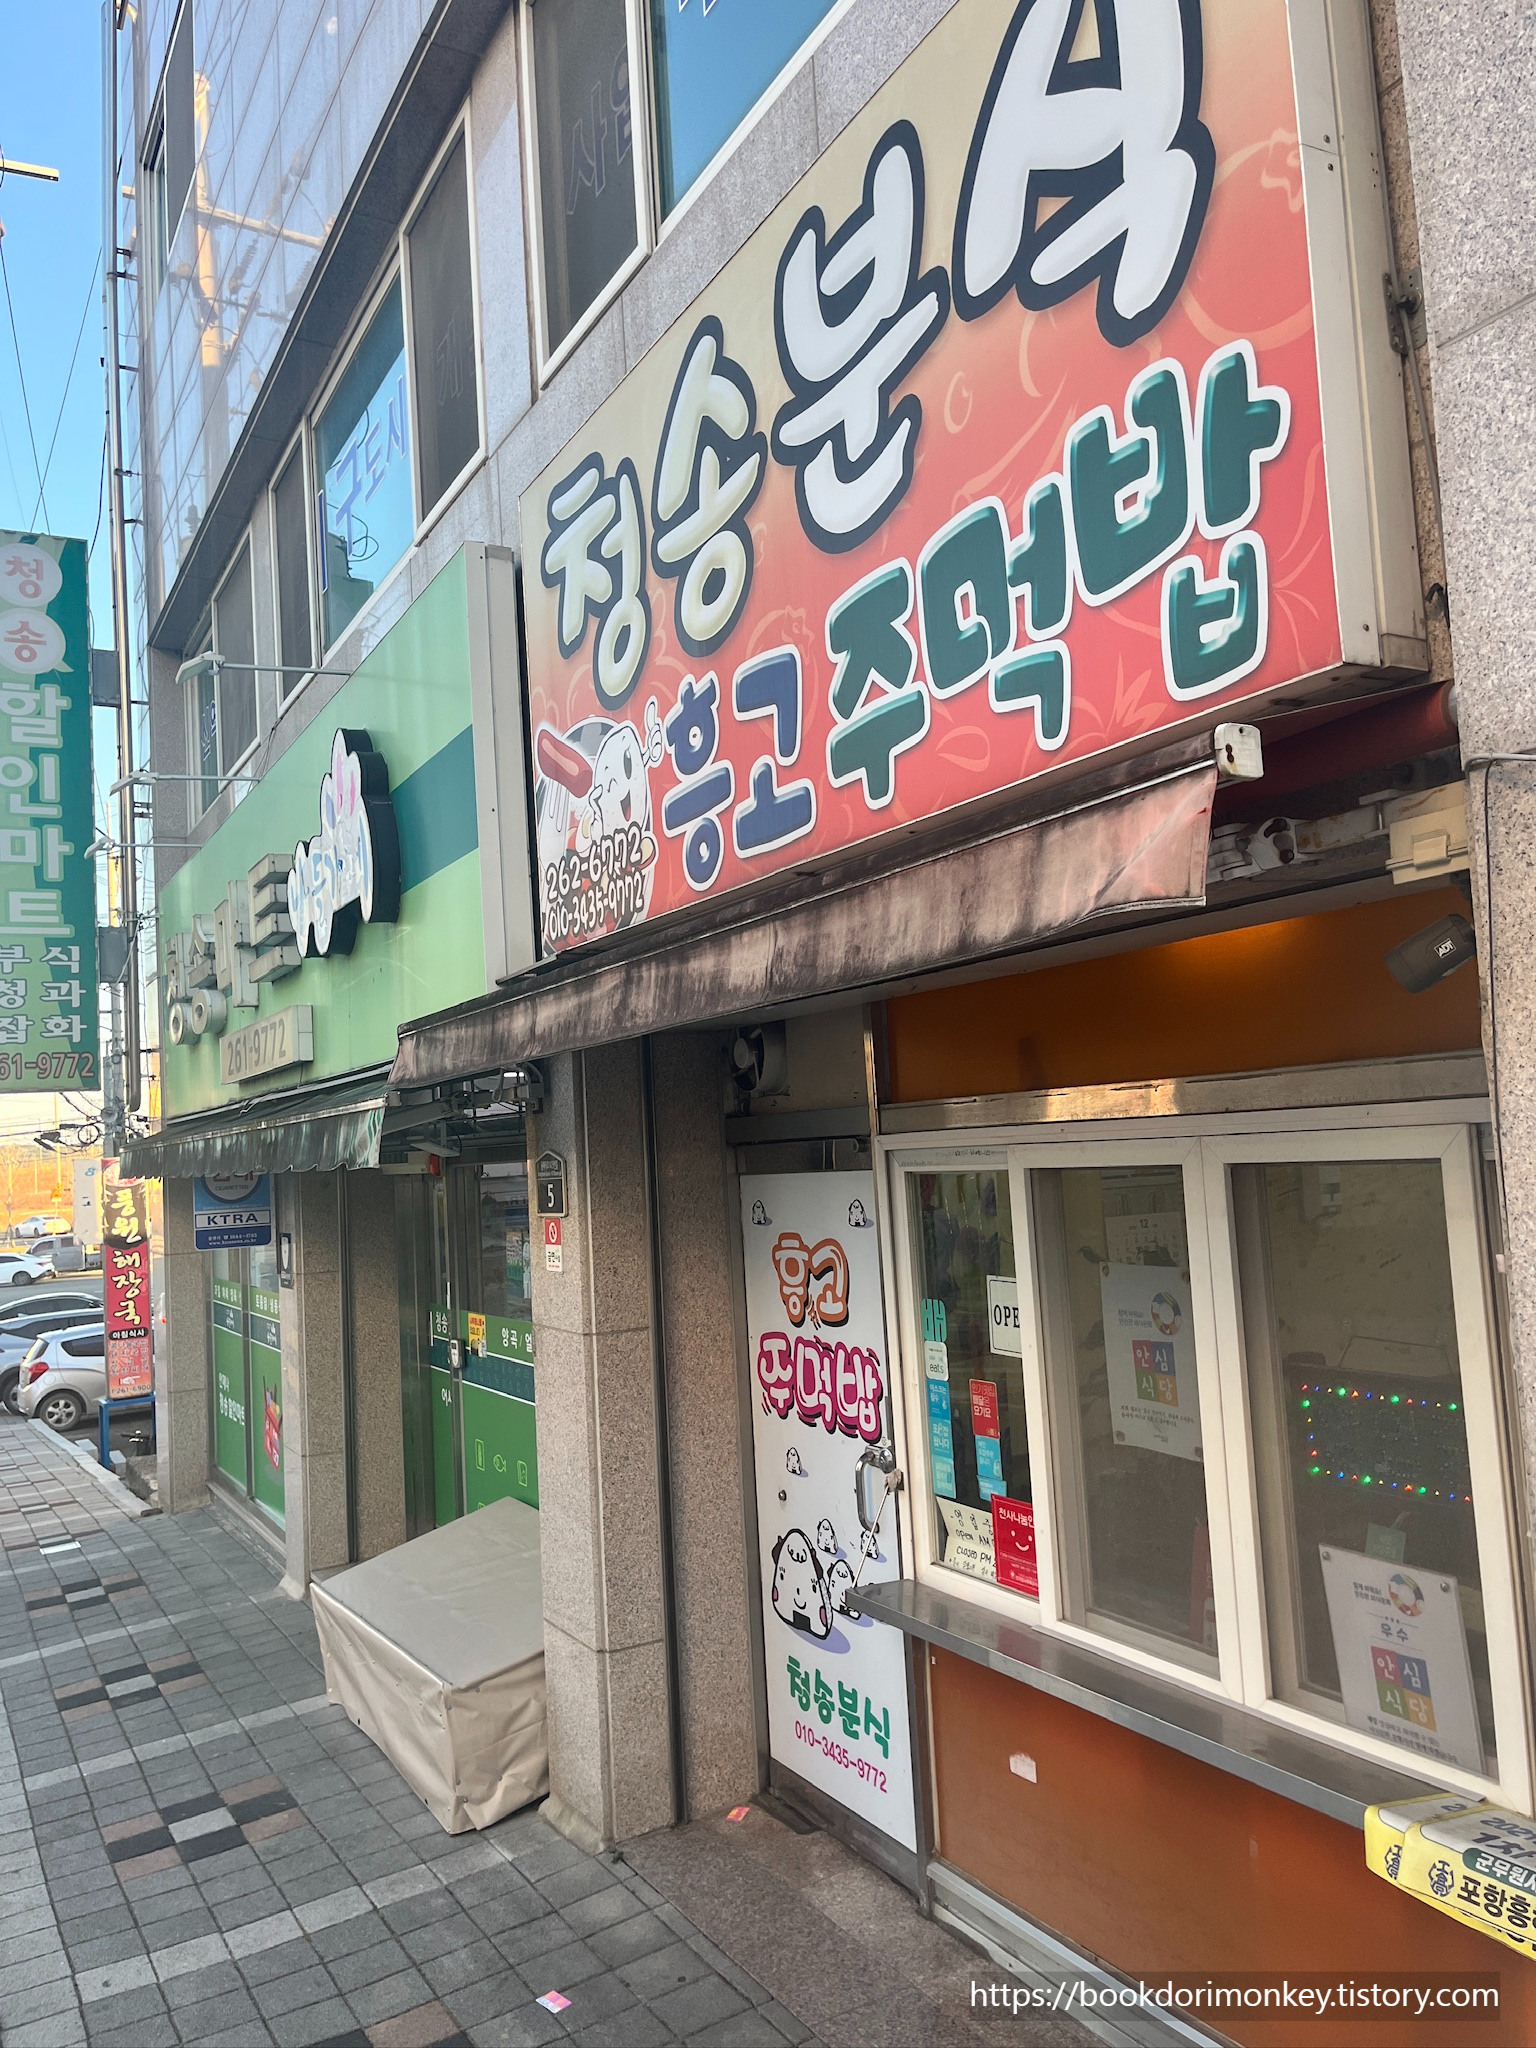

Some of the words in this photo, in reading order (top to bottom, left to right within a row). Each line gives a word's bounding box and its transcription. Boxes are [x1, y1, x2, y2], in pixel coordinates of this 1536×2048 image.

[828, 340, 1290, 808] 주먹밥
[546, 824, 642, 901] 262-6772
[547, 870, 644, 941] 010-3435-9772
[1438, 940, 1455, 957] ADT
[227, 1017, 287, 1077] 261-9772
[111, 1188, 141, 1244] 풍원
[207, 1212, 258, 1226] KTRA
[547, 1183, 555, 1208] 5
[112, 1250, 143, 1325] 해장국
[929, 1363, 944, 1374] eats
[1136, 1345, 1168, 1372] 안심
[756, 1331, 883, 1444] 주먹밥
[1142, 1375, 1173, 1401] 식당
[1381, 1623, 1409, 1642] 우수
[1377, 1655, 1421, 1688] 안심
[786, 1655, 890, 1760] 청송분식
[1386, 1689, 1428, 1723] 식당
[795, 1720, 888, 1794] 010-3435-9772
[1457, 1875, 1536, 1928] 포항흥
